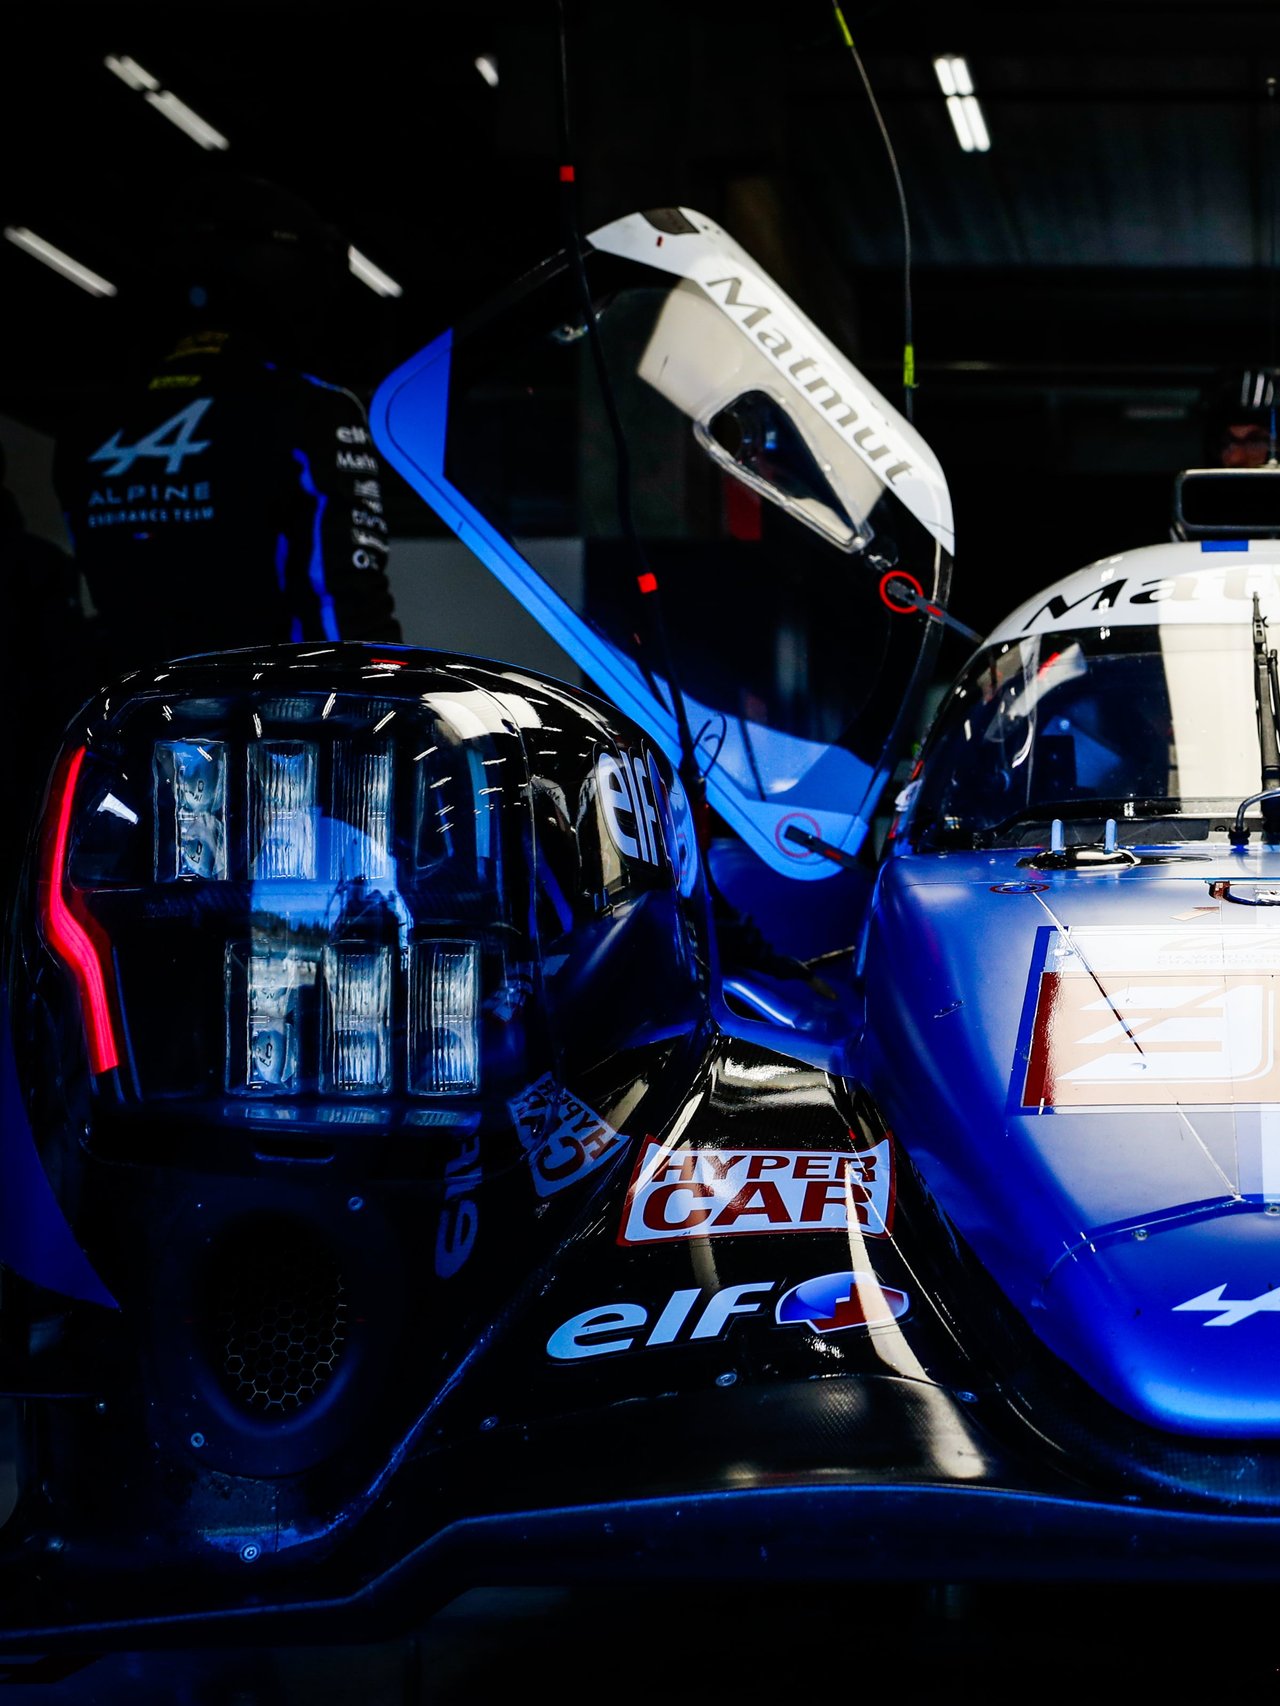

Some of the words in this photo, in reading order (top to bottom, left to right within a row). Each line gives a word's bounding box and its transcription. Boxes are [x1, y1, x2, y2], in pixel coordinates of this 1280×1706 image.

[706, 277, 914, 486] Matmut
[87, 480, 212, 508] ALPINE
[597, 750, 660, 867] elf
[650, 1154, 878, 1182] HYPER
[643, 1181, 871, 1231] CAR
[545, 1281, 775, 1360] elf
